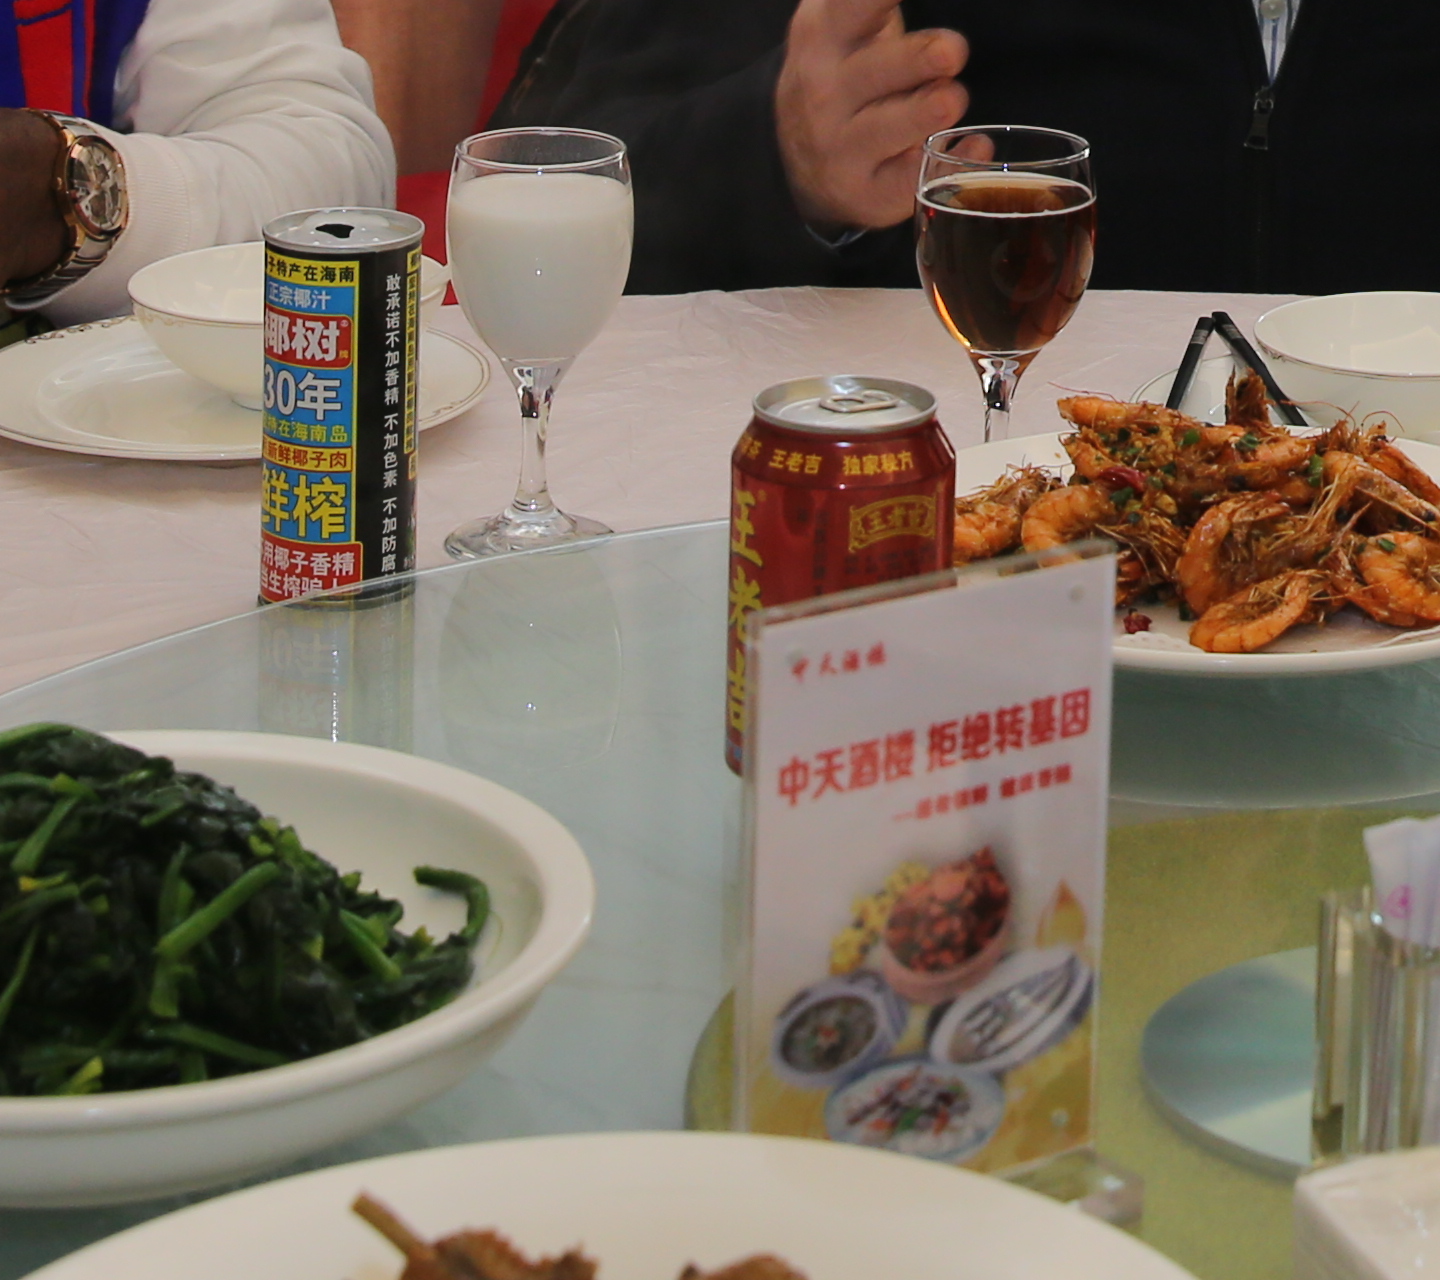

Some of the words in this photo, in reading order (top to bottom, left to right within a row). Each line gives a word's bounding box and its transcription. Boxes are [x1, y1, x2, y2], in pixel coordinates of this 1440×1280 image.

[266, 254, 355, 283] 子特产在海南
[268, 281, 332, 310] 正宗椰汁
[384, 273, 402, 406] 敢承诺不加香精
[263, 438, 347, 468] 新鲜椰子肉
[383, 413, 399, 489] 不加色素
[769, 449, 822, 474] 王老吉
[381, 496, 398, 576] 不加防腐
[262, 540, 355, 576] 用椰子香精
[778, 728, 916, 807] 中天酒楼
[926, 687, 1091, 773] 拒绝转基因
